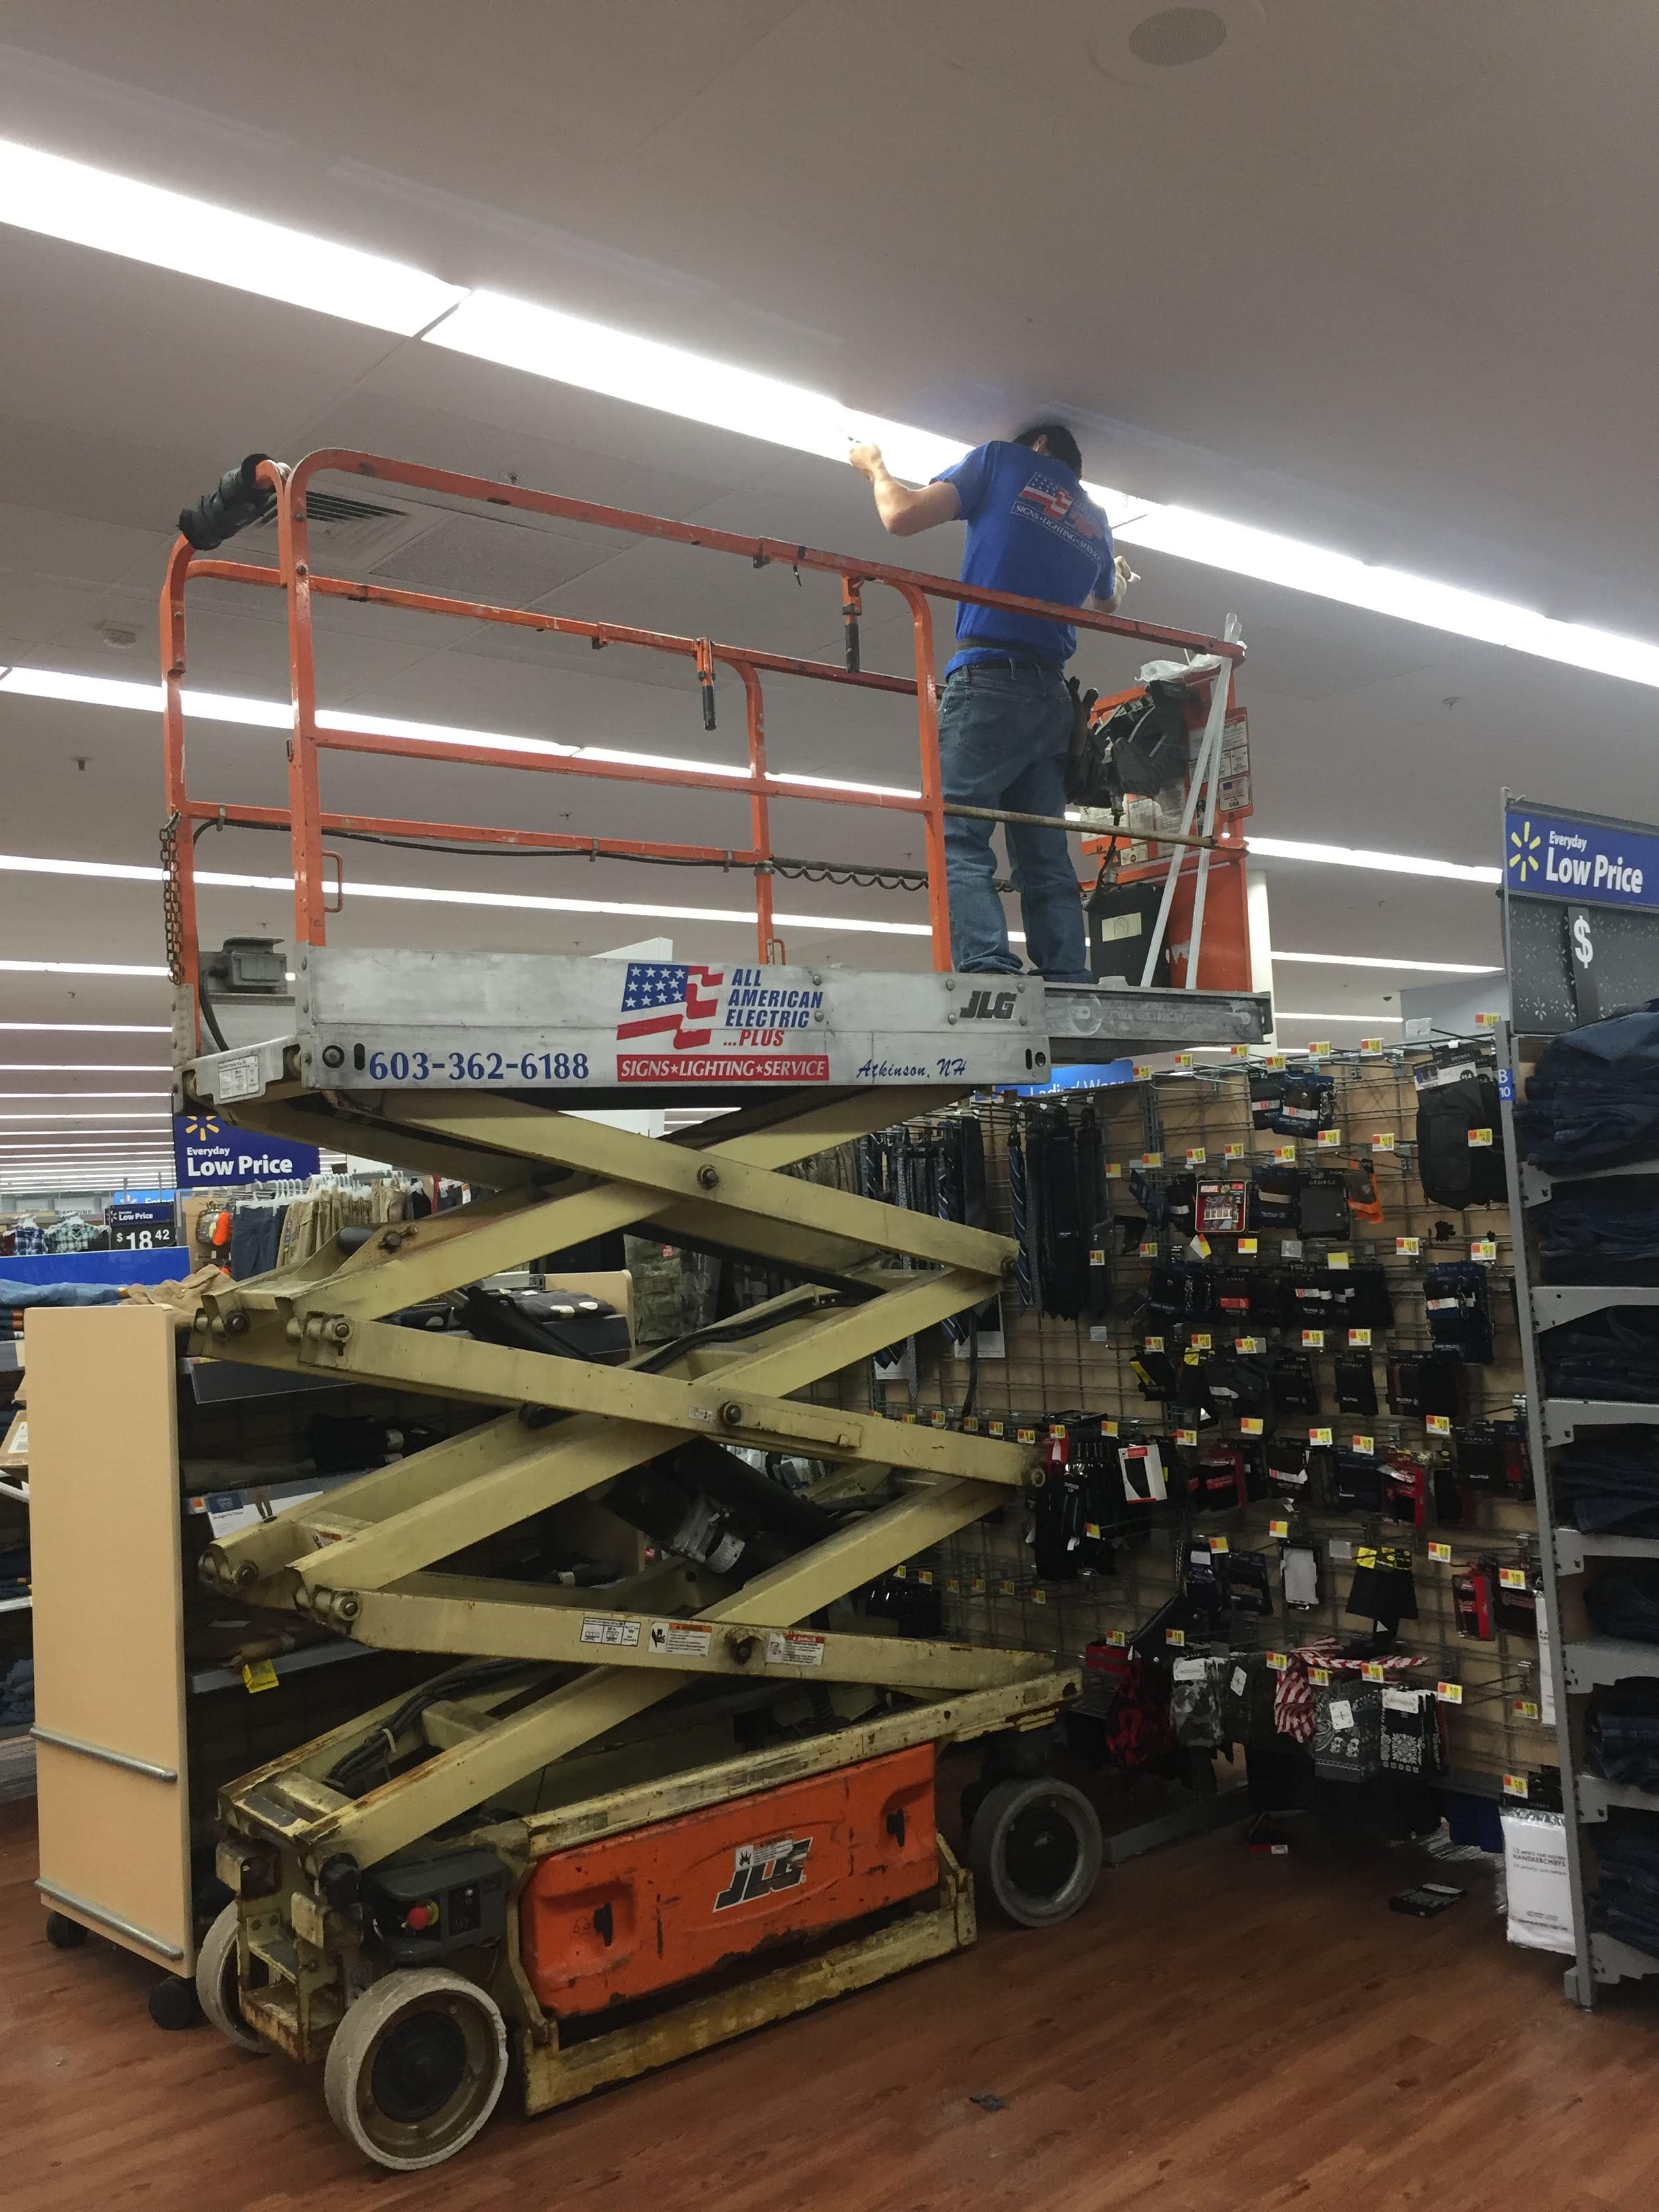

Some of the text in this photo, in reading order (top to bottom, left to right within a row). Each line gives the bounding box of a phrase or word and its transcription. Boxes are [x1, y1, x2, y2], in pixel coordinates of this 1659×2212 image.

[1017, 504, 1040, 521] SIGNS
[1043, 516, 1077, 543] LIGHTING
[1549, 830, 1587, 853] Everyday
[1546, 847, 1643, 894] Low Price
[1574, 915, 1593, 969] $
[731, 968, 762, 987] ALL
[727, 989, 823, 1008] AMERICAN
[960, 990, 1017, 1020] JLG
[725, 1009, 810, 1028] ELECTRIC
[369, 1052, 590, 1080] 603-362-6188
[621, 1060, 825, 1077] SIGNS LIGHTING SERVICE
[856, 1059, 967, 1079] Atkinson, NH
[1498, 1069, 1511, 1097] B 10
[186, 1146, 230, 1158] Everyday
[187, 1154, 293, 1176] Low Price
[119, 1213, 135, 1221] Low
[135, 1212, 153, 1221] Price
[116, 1229, 170, 1250] $ 18 42
